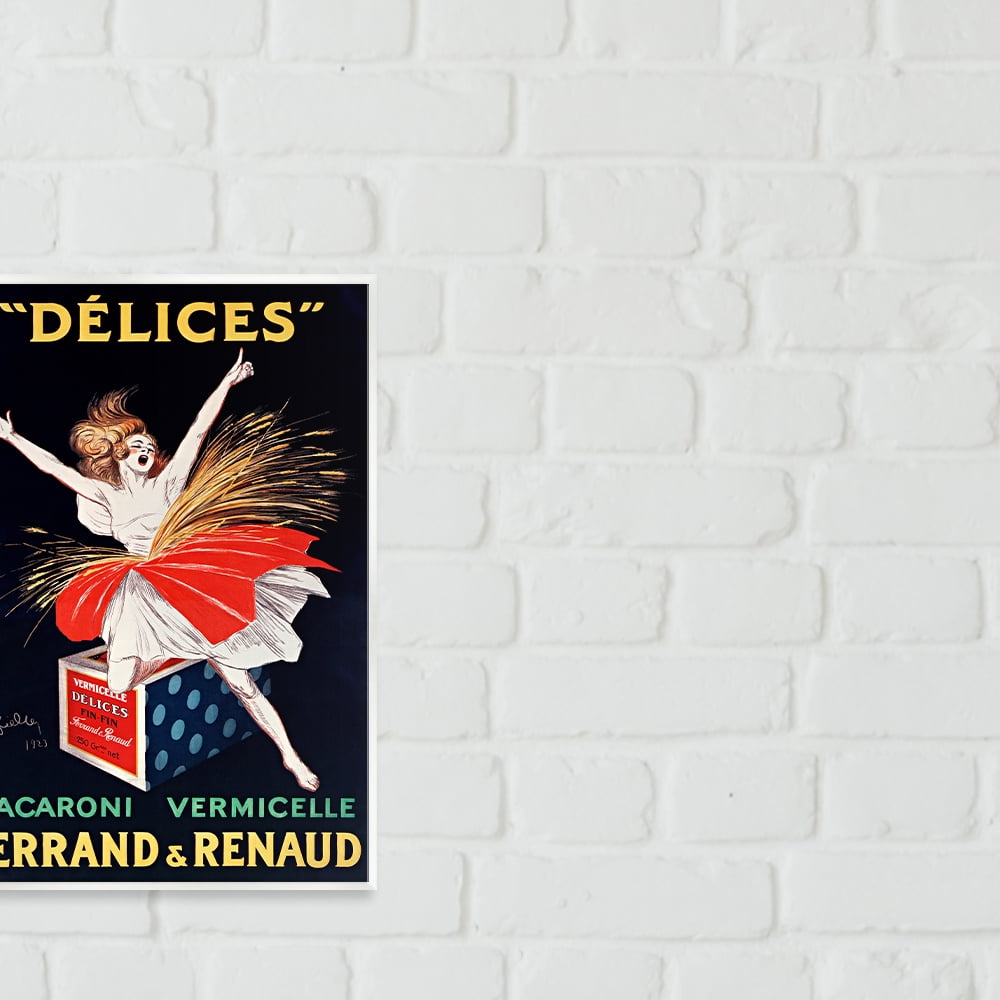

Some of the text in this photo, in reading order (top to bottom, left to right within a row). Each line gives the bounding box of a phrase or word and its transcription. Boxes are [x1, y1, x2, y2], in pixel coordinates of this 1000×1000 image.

[80, 707, 119, 728] FIN FIN
[107, 750, 120, 760] net
[167, 796, 356, 818] VERMICELLE
[166, 845, 188, 868] &
[193, 832, 362, 869] RENAUD
